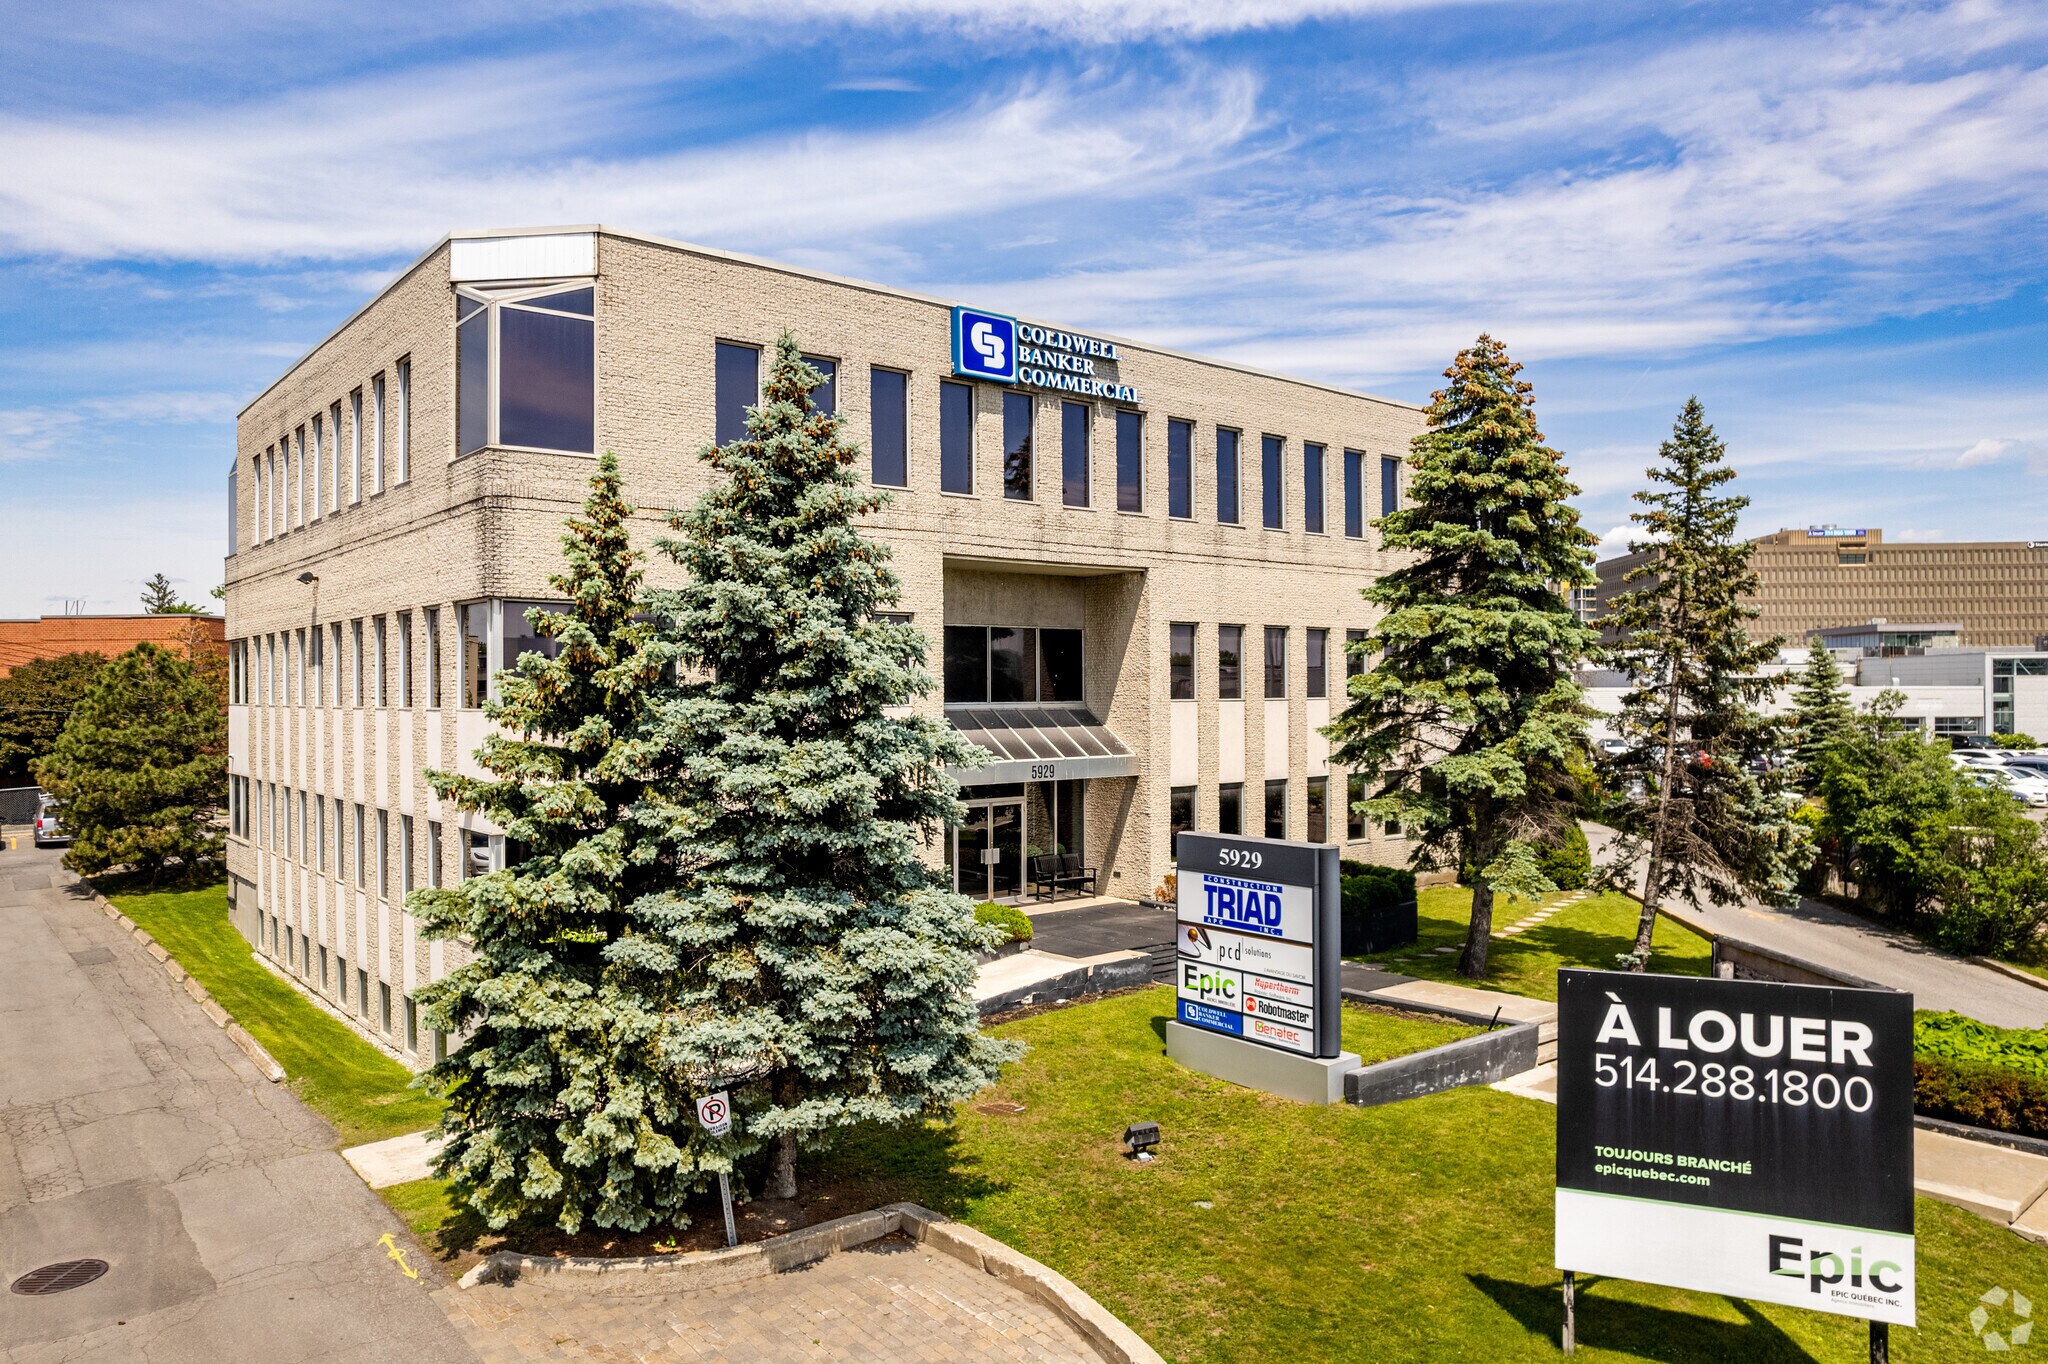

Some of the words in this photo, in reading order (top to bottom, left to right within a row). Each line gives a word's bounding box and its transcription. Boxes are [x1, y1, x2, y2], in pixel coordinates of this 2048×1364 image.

[1018, 324, 1123, 361] COLDWELL
[1018, 345, 1095, 376] BANKER
[1018, 366, 1144, 404] COMMERCIAL
[1031, 764, 1055, 779] 5929
[1219, 848, 1263, 869] 5929
[1207, 875, 1278, 893] CONSTRUCTION
[1203, 883, 1281, 927] TRIAD
[1207, 917, 1224, 925] APG
[1244, 946, 1272, 960] solutions
[1184, 963, 1236, 1000] Epic
[1254, 977, 1300, 996] Hypertherm
[1198, 1005, 1227, 1018] COLDWELL
[1198, 1011, 1220, 1021] BANKER
[1258, 1000, 1309, 1024] Robotmaster
[1198, 1017, 1234, 1030] COMMERCIAL
[1254, 1020, 1300, 1043] Genatec
[1595, 991, 1641, 1047] À
[1658, 1006, 1874, 1067] LOUER
[1594, 1052, 1874, 1113] 514.288.1800
[1594, 1145, 1674, 1165] TOUJOURS
[1677, 1155, 1752, 1175] BRANCHÉ
[1594, 1163, 1711, 1186] epicquebec.com
[1769, 1234, 1903, 1294] Epic
[1831, 1290, 1849, 1299] EPIC
[1850, 1292, 1884, 1305] QUÉBEC
[1885, 1299, 1903, 1308] INC.
